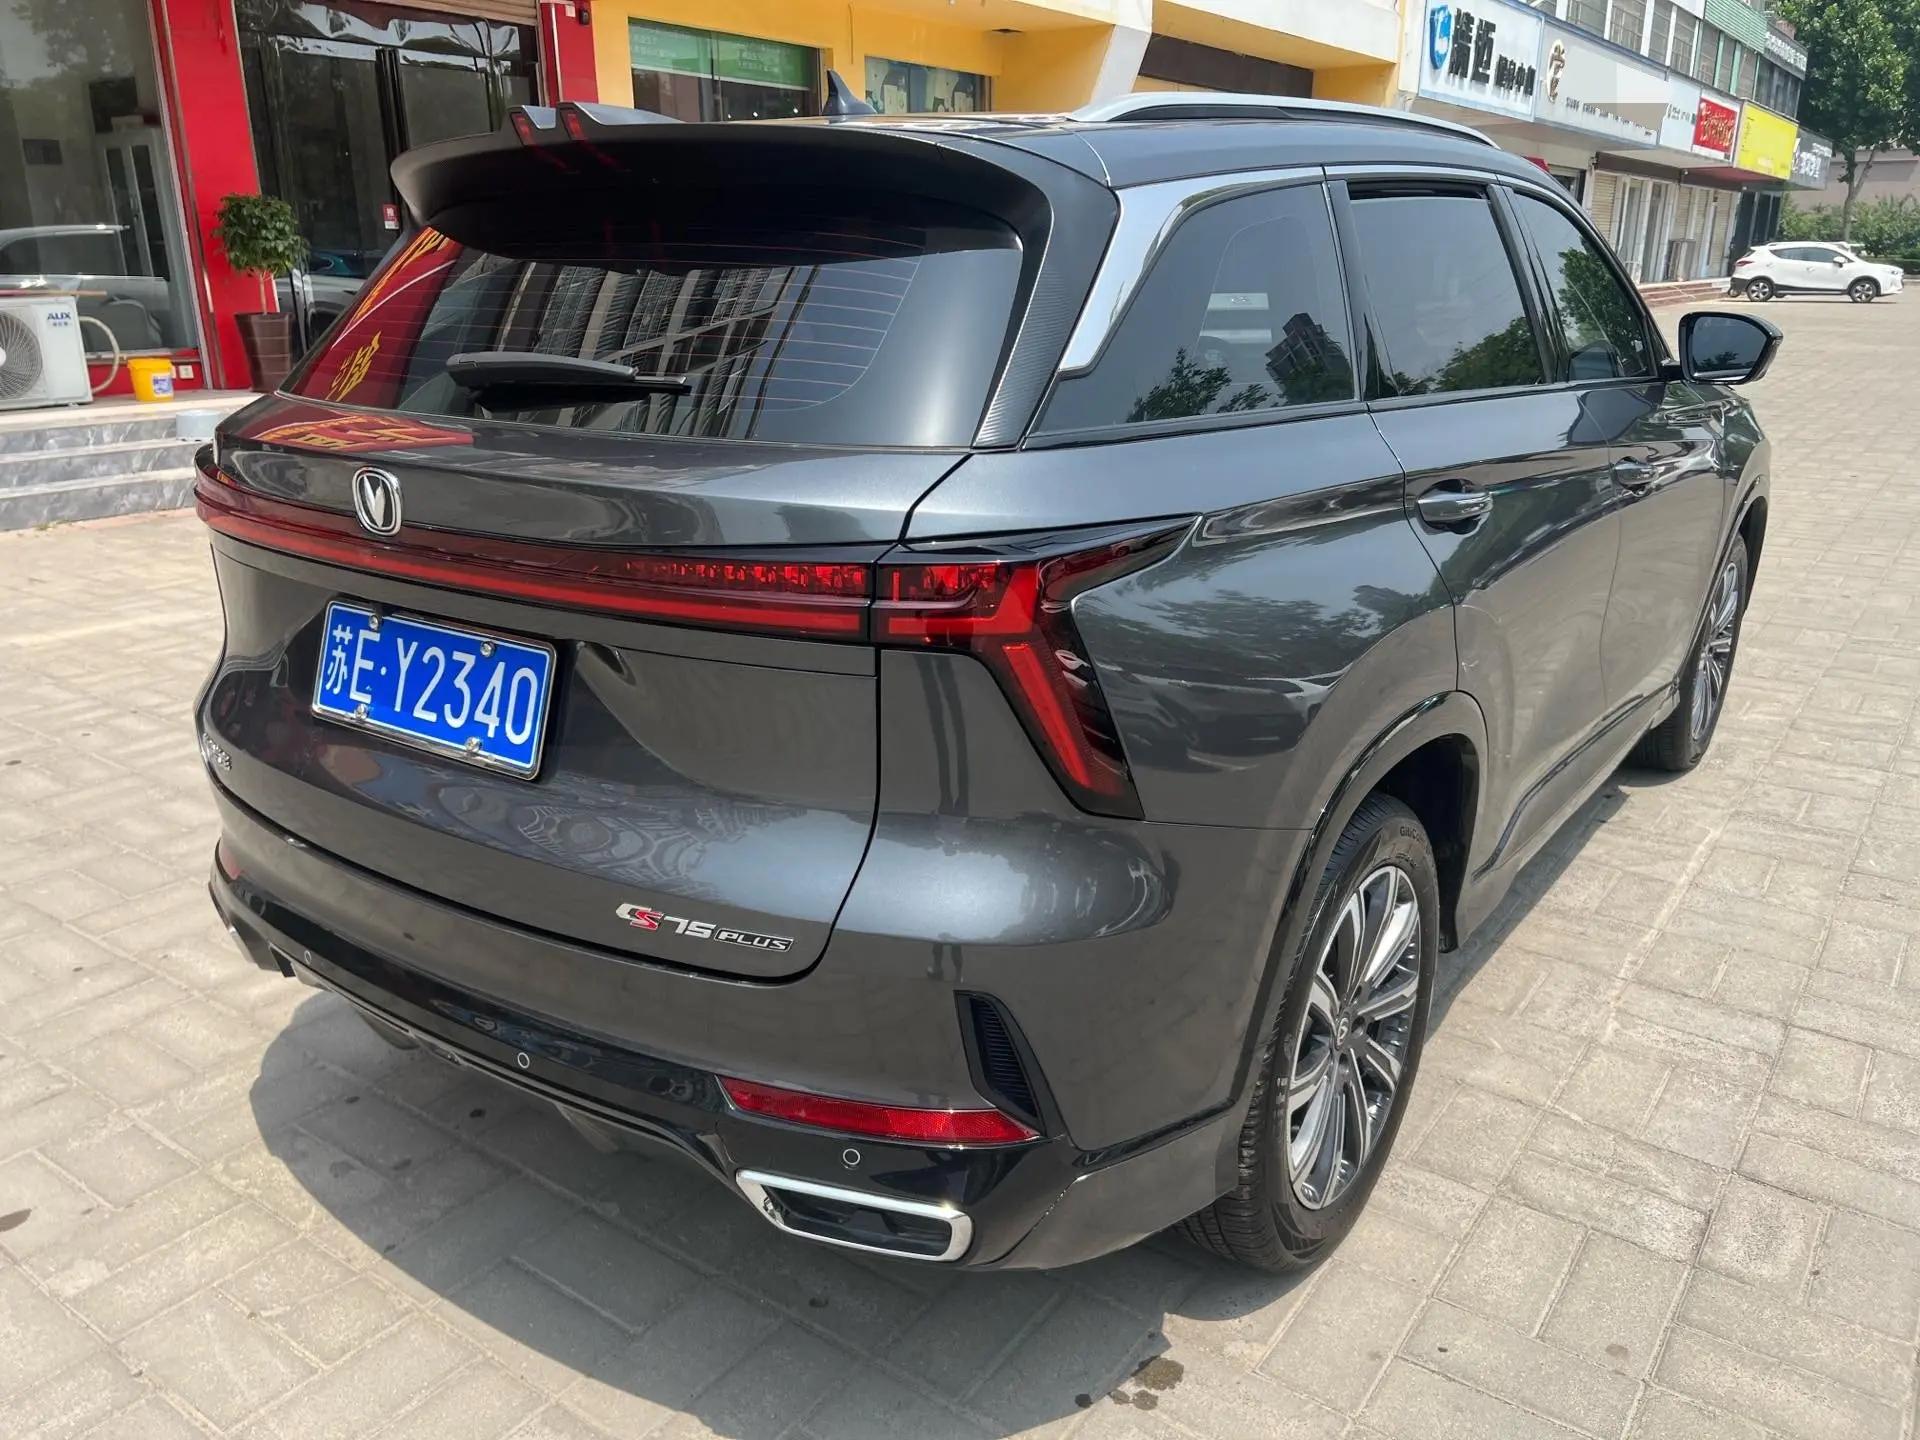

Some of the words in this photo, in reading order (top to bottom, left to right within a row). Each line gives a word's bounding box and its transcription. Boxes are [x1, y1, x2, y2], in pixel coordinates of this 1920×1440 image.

[47, 312, 71, 320] AUX
[325, 624, 538, 745] 苏E·Y2340
[717, 930, 789, 950] PLUS
